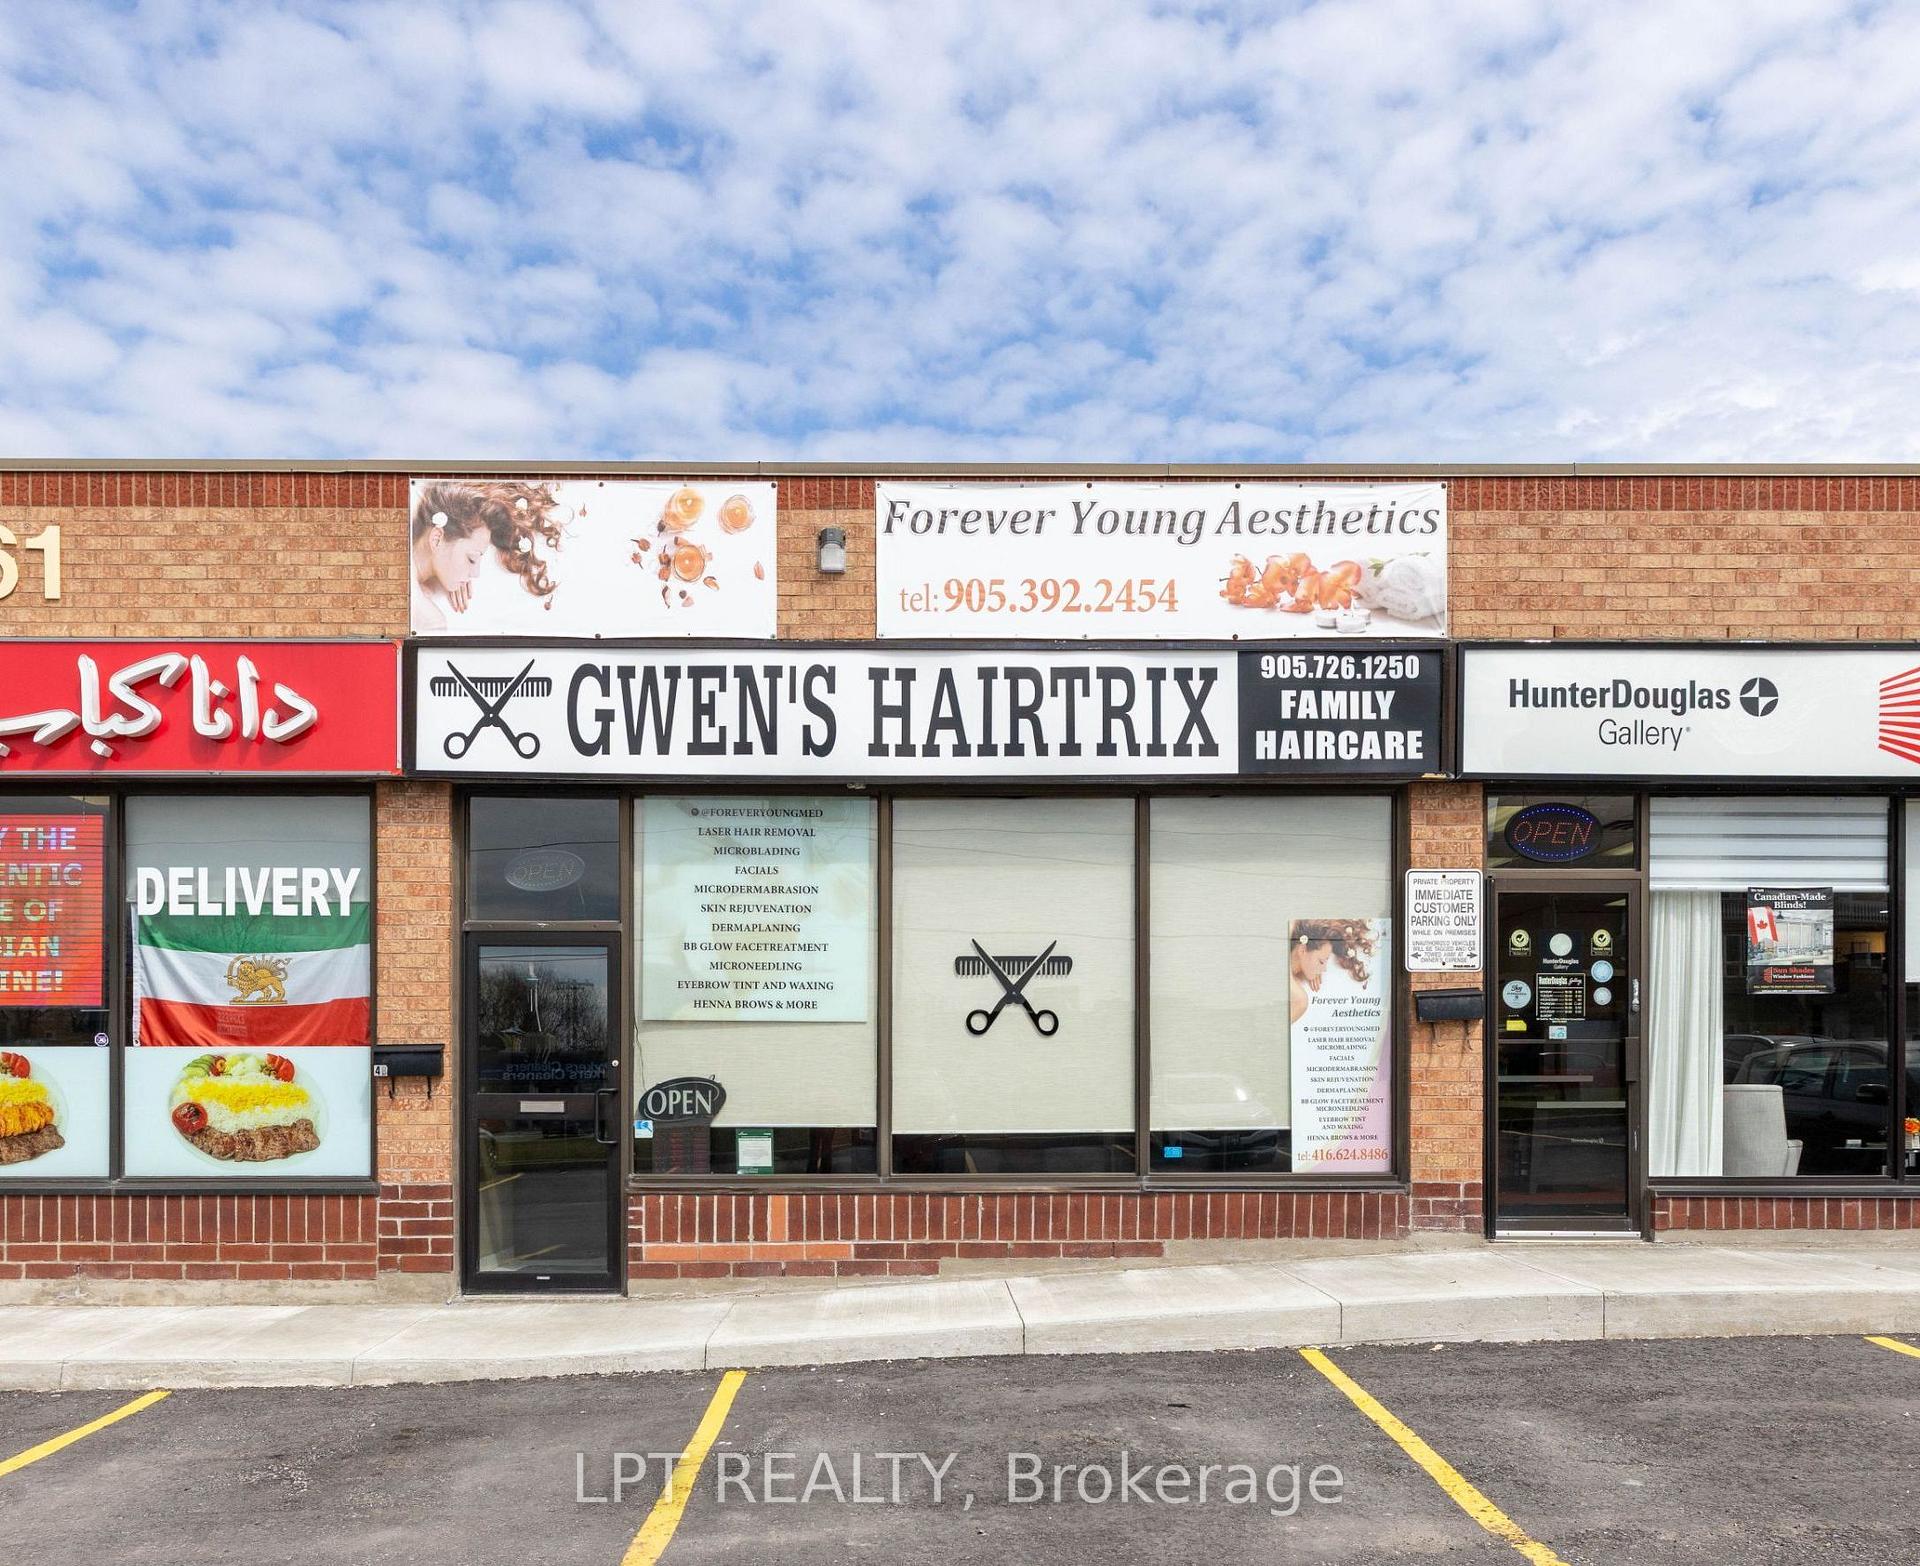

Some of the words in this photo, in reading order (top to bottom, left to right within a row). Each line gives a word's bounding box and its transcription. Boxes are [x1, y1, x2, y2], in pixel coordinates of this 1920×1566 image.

[882, 499, 1055, 536] Forever
[1070, 499, 1206, 546] Young
[1214, 499, 1441, 536] Aesthetics
[900, 582, 939, 613] tel:
[943, 577, 1179, 613] 905.392.2454
[1260, 654, 1421, 680] 905.726.1250
[190, 654, 318, 743] دانا
[1508, 678, 1731, 716] HunterDouglas
[567, 662, 837, 758] GWEN'S
[868, 666, 1219, 758] HAIRTRIX
[1280, 689, 1396, 721] FAMILY
[1255, 730, 1424, 760] HAIRCARE
[698, 827, 732, 837] LASER
[734, 827, 762, 837] HAIR
[764, 827, 816, 837] REMOVAL
[1513, 820, 1592, 846] OPEN
[16, 828, 76, 849] THE
[713, 847, 800, 856] MICROBLADING
[0, 863, 82, 886] NTIC
[735, 866, 778, 875] FACIALS
[137, 866, 361, 916] DELIVERY
[694, 885, 819, 894] MICRODERMABRASION
[1415, 889, 1473, 900] IMMEDIATE
[1754, 892, 1826, 901] Canadian-Made
[23, 899, 63, 922] OF
[701, 904, 727, 913] SKIN
[729, 904, 812, 914] REJUVENATION
[1414, 902, 1474, 914] CUSTOMER
[1774, 901, 1807, 909] Blinds!
[1411, 915, 1450, 926] PARKING
[1453, 915, 1477, 926] ONLY
[712, 923, 801, 933] DERMAPLANING
[0, 936, 60, 957] IAN
[683, 942, 698, 951] BB
[700, 942, 733, 952] GLOW
[735, 942, 829, 952] FACETREATMENT
[709, 961, 802, 971] MICRONEEDLING
[677, 980, 730, 990] EYEBROW
[733, 980, 760, 990] TINT
[762, 980, 787, 990] AND
[789, 981, 834, 990] WAXING
[693, 999, 732, 1009] HENNA
[735, 999, 773, 1009] BROWS
[775, 1000, 784, 1009] &
[786, 1000, 818, 1009] MORE
[1311, 996, 1348, 1005] Forever
[1351, 995, 1381, 1006] Young
[1331, 1008, 1381, 1017] Aesthetics
[647, 1089, 712, 1116] OPEN
[1312, 1148, 1388, 1160] 416.624.8486
